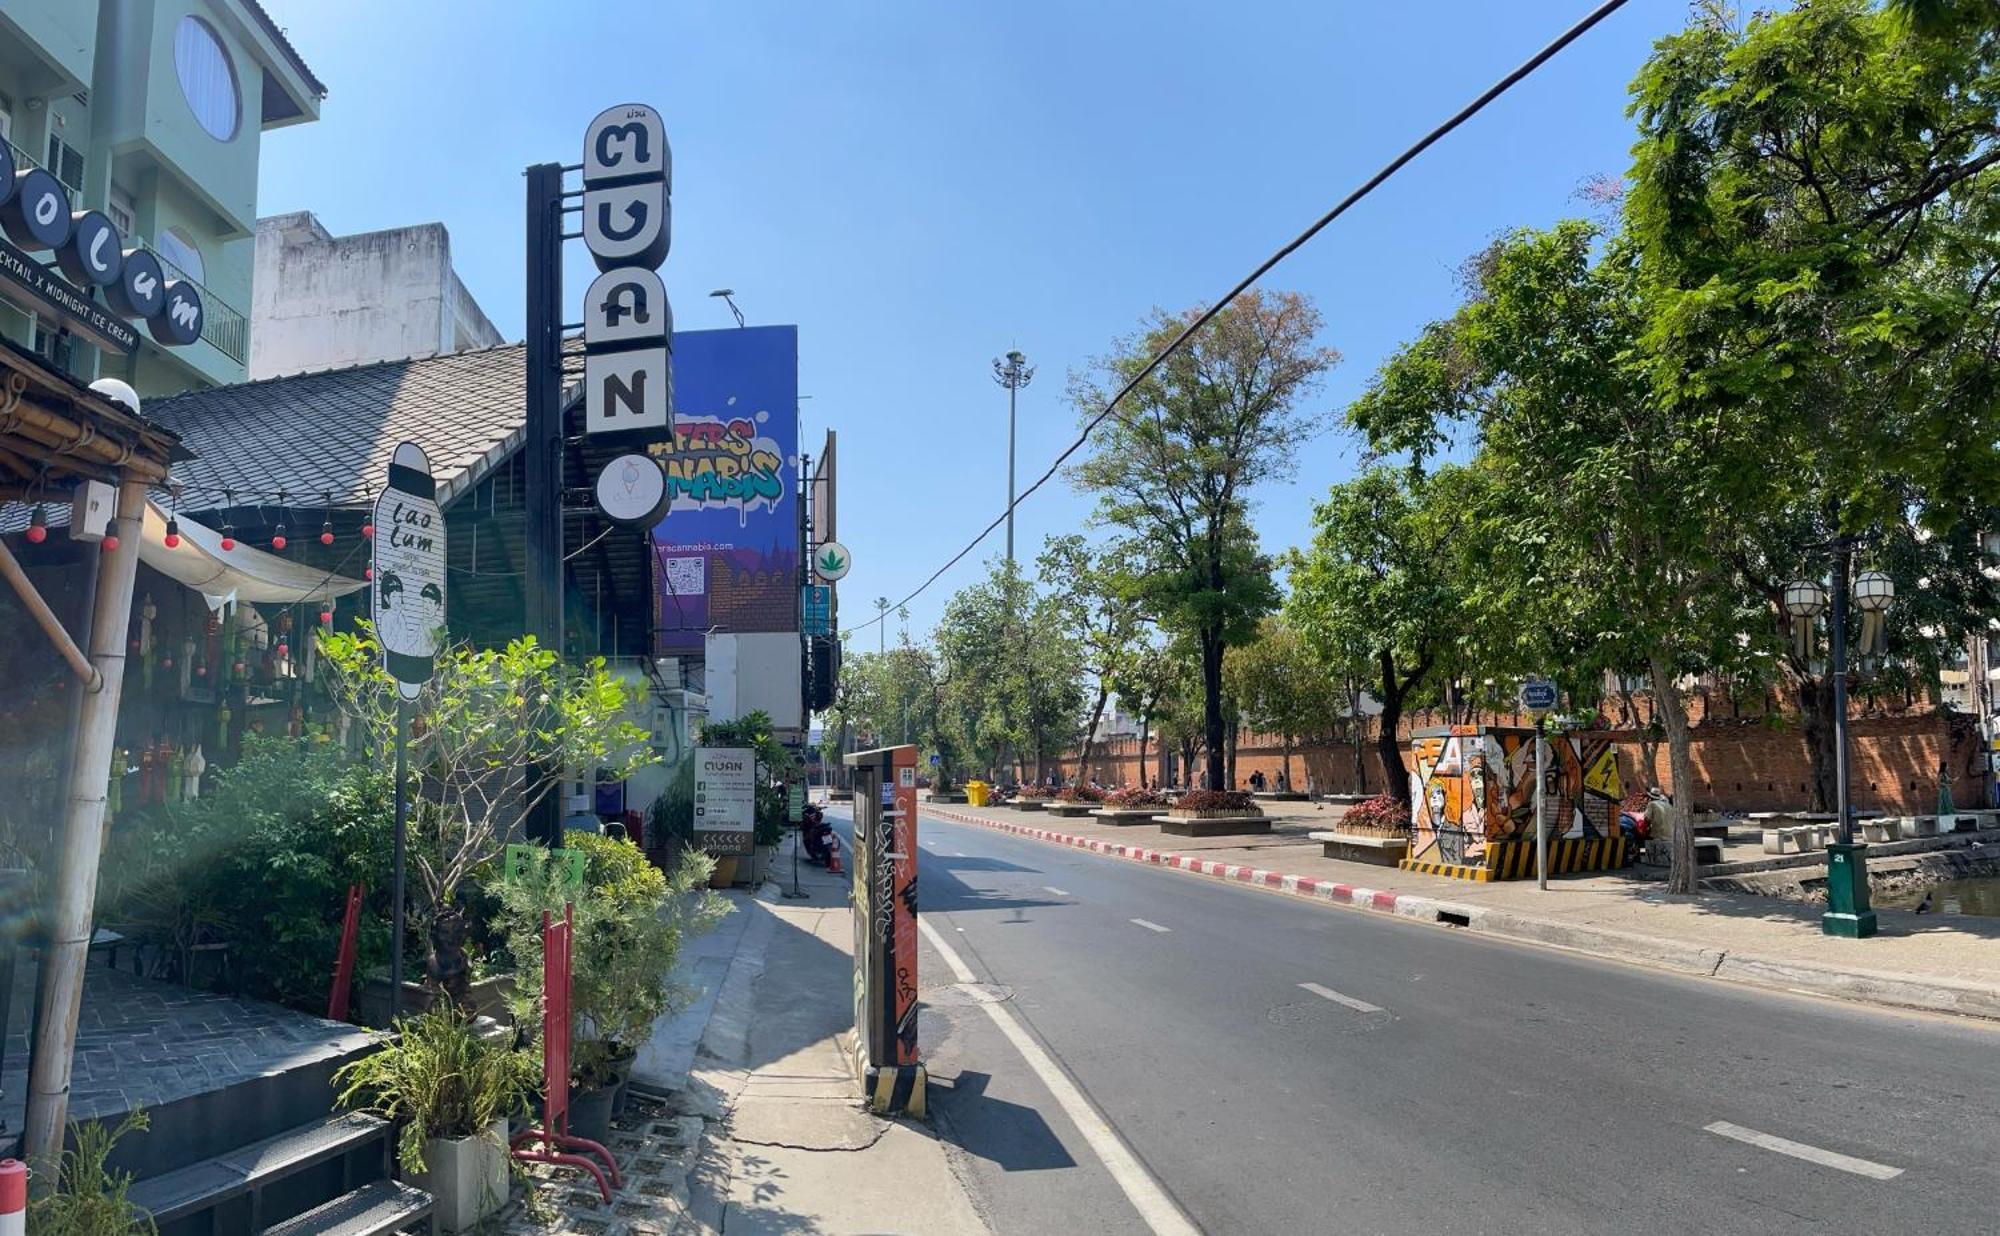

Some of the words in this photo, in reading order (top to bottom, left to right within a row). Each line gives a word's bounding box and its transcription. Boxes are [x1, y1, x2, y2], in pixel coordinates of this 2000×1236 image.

[35, 275, 44, 289] X
[46, 282, 90, 318] MIDNIGHT
[91, 311, 106, 329] ICE
[107, 321, 134, 346] CREAM
[1834, 854, 1844, 863] 21
